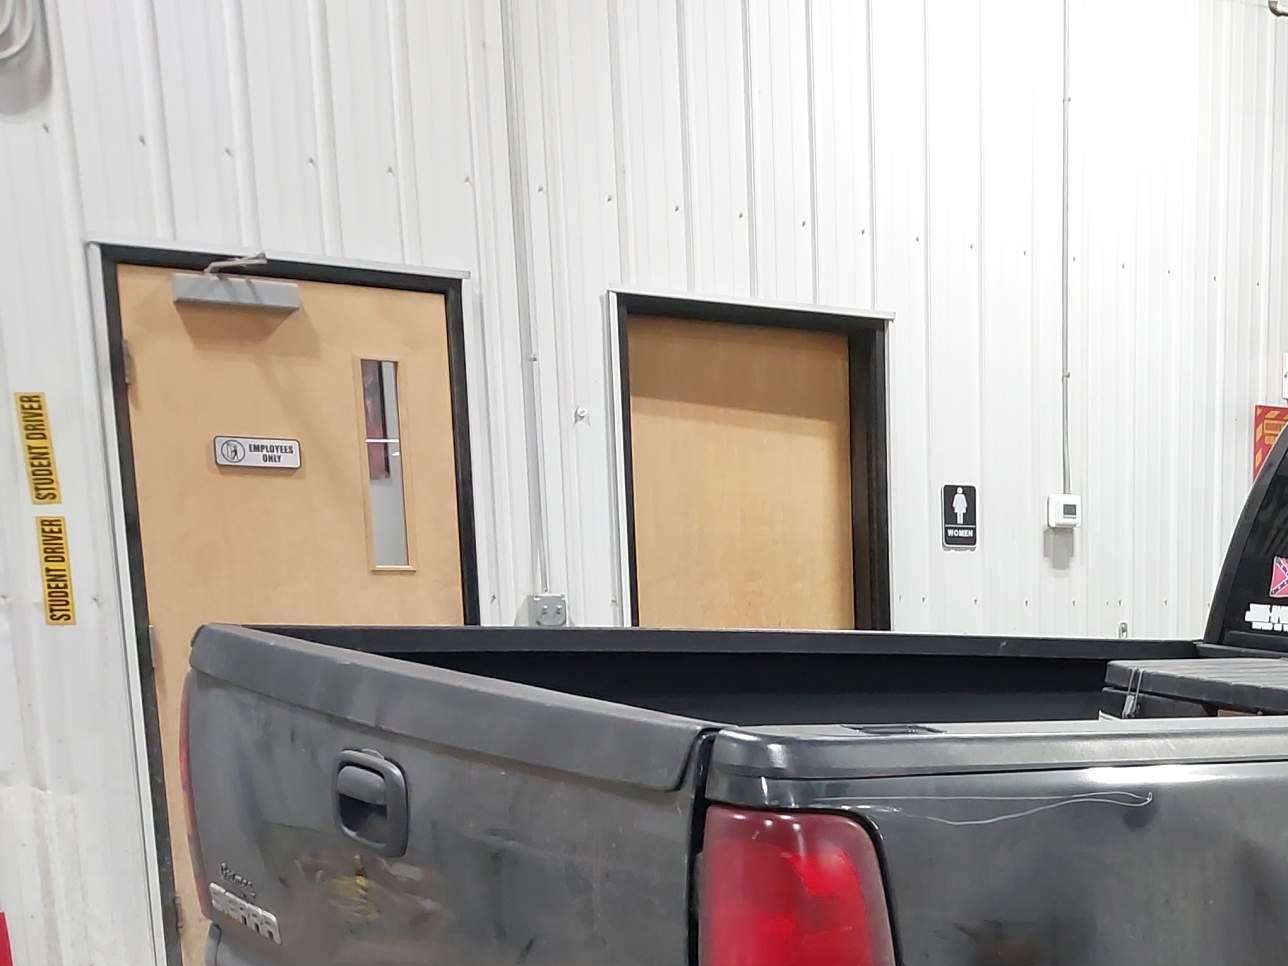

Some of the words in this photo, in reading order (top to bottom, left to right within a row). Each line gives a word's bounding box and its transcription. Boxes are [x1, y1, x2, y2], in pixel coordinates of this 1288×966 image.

[19, 394, 46, 440] DRIVER
[248, 443, 294, 454] EMPLOYEES
[262, 454, 282, 463] ONLY
[27, 445, 58, 501] STUDENT
[40, 518, 66, 563] DRIVER
[947, 529, 973, 537] WOMEN
[45, 567, 72, 622] STUDENT
